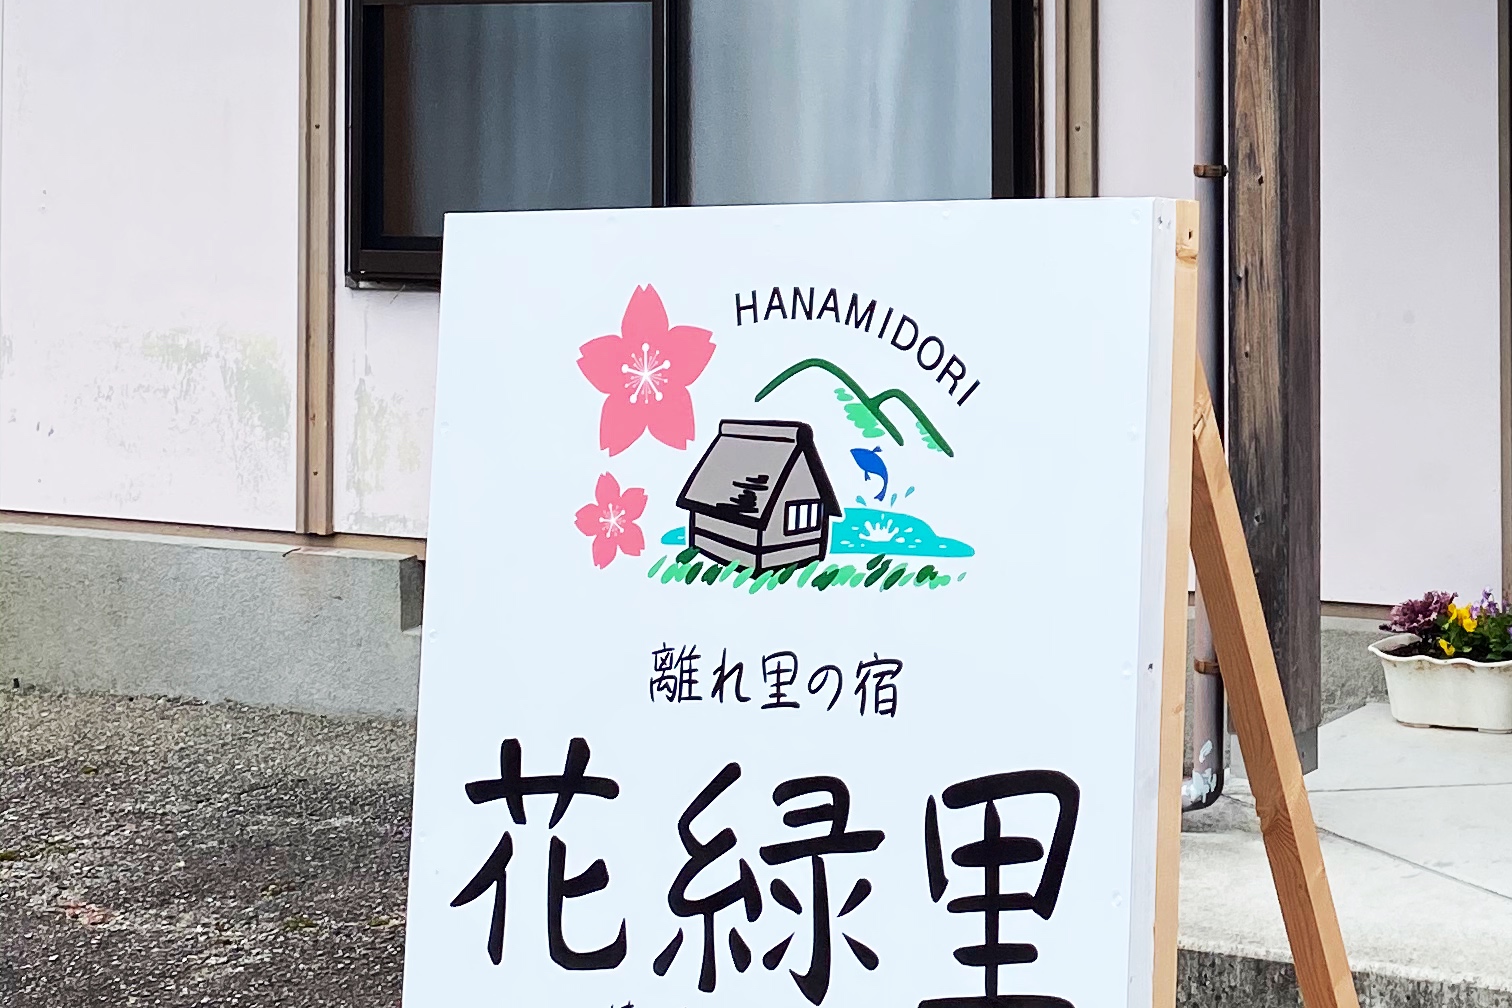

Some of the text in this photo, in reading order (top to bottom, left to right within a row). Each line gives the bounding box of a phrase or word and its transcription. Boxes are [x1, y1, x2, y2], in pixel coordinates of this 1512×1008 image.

[735, 286, 981, 407] HANAMIDORI
[649, 642, 903, 718] 離れ里の宿
[450, 737, 1081, 1008] 花緑里
